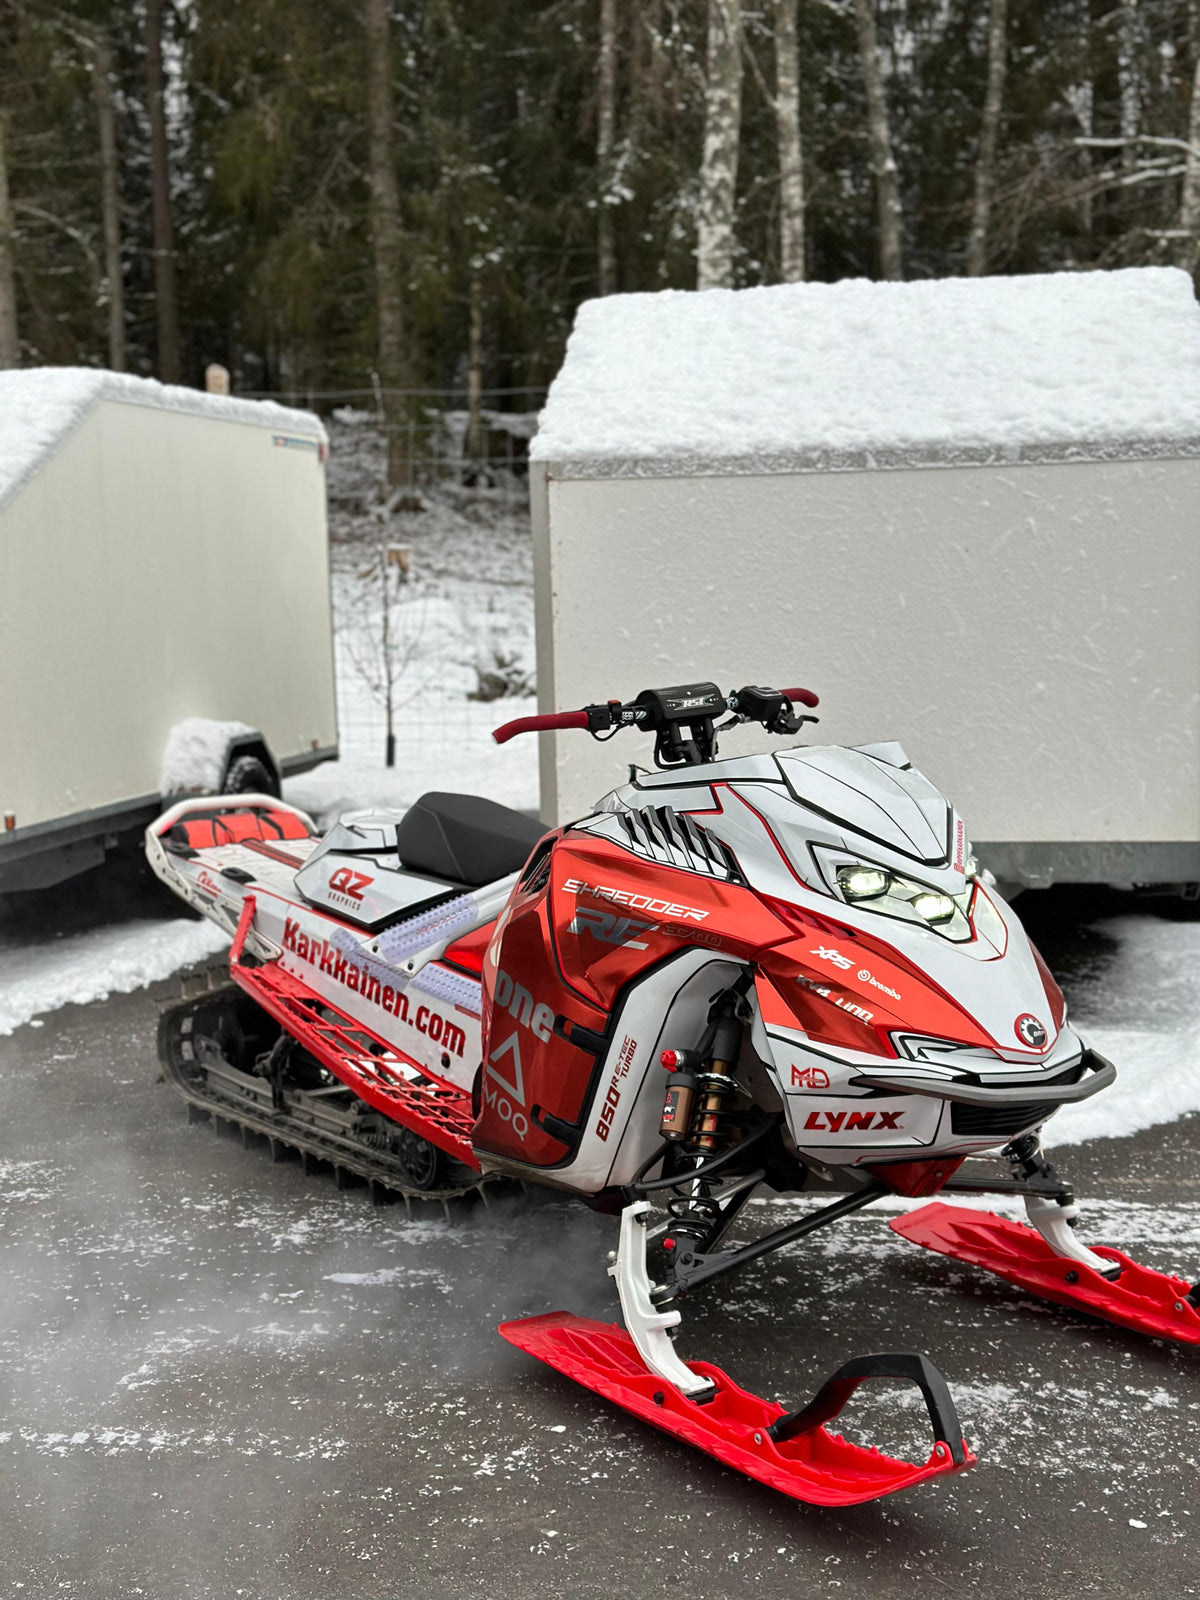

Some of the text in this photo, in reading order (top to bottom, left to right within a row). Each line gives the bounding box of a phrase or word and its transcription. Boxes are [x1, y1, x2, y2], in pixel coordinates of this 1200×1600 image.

[328, 867, 375, 902] QZ
[561, 878, 711, 922] SHREDDER
[809, 945, 856, 970] XPS
[282, 917, 466, 1058] Karkkainen.com
[620, 1039, 638, 1079] TURBO
[803, 1111, 906, 1133] LYNX
